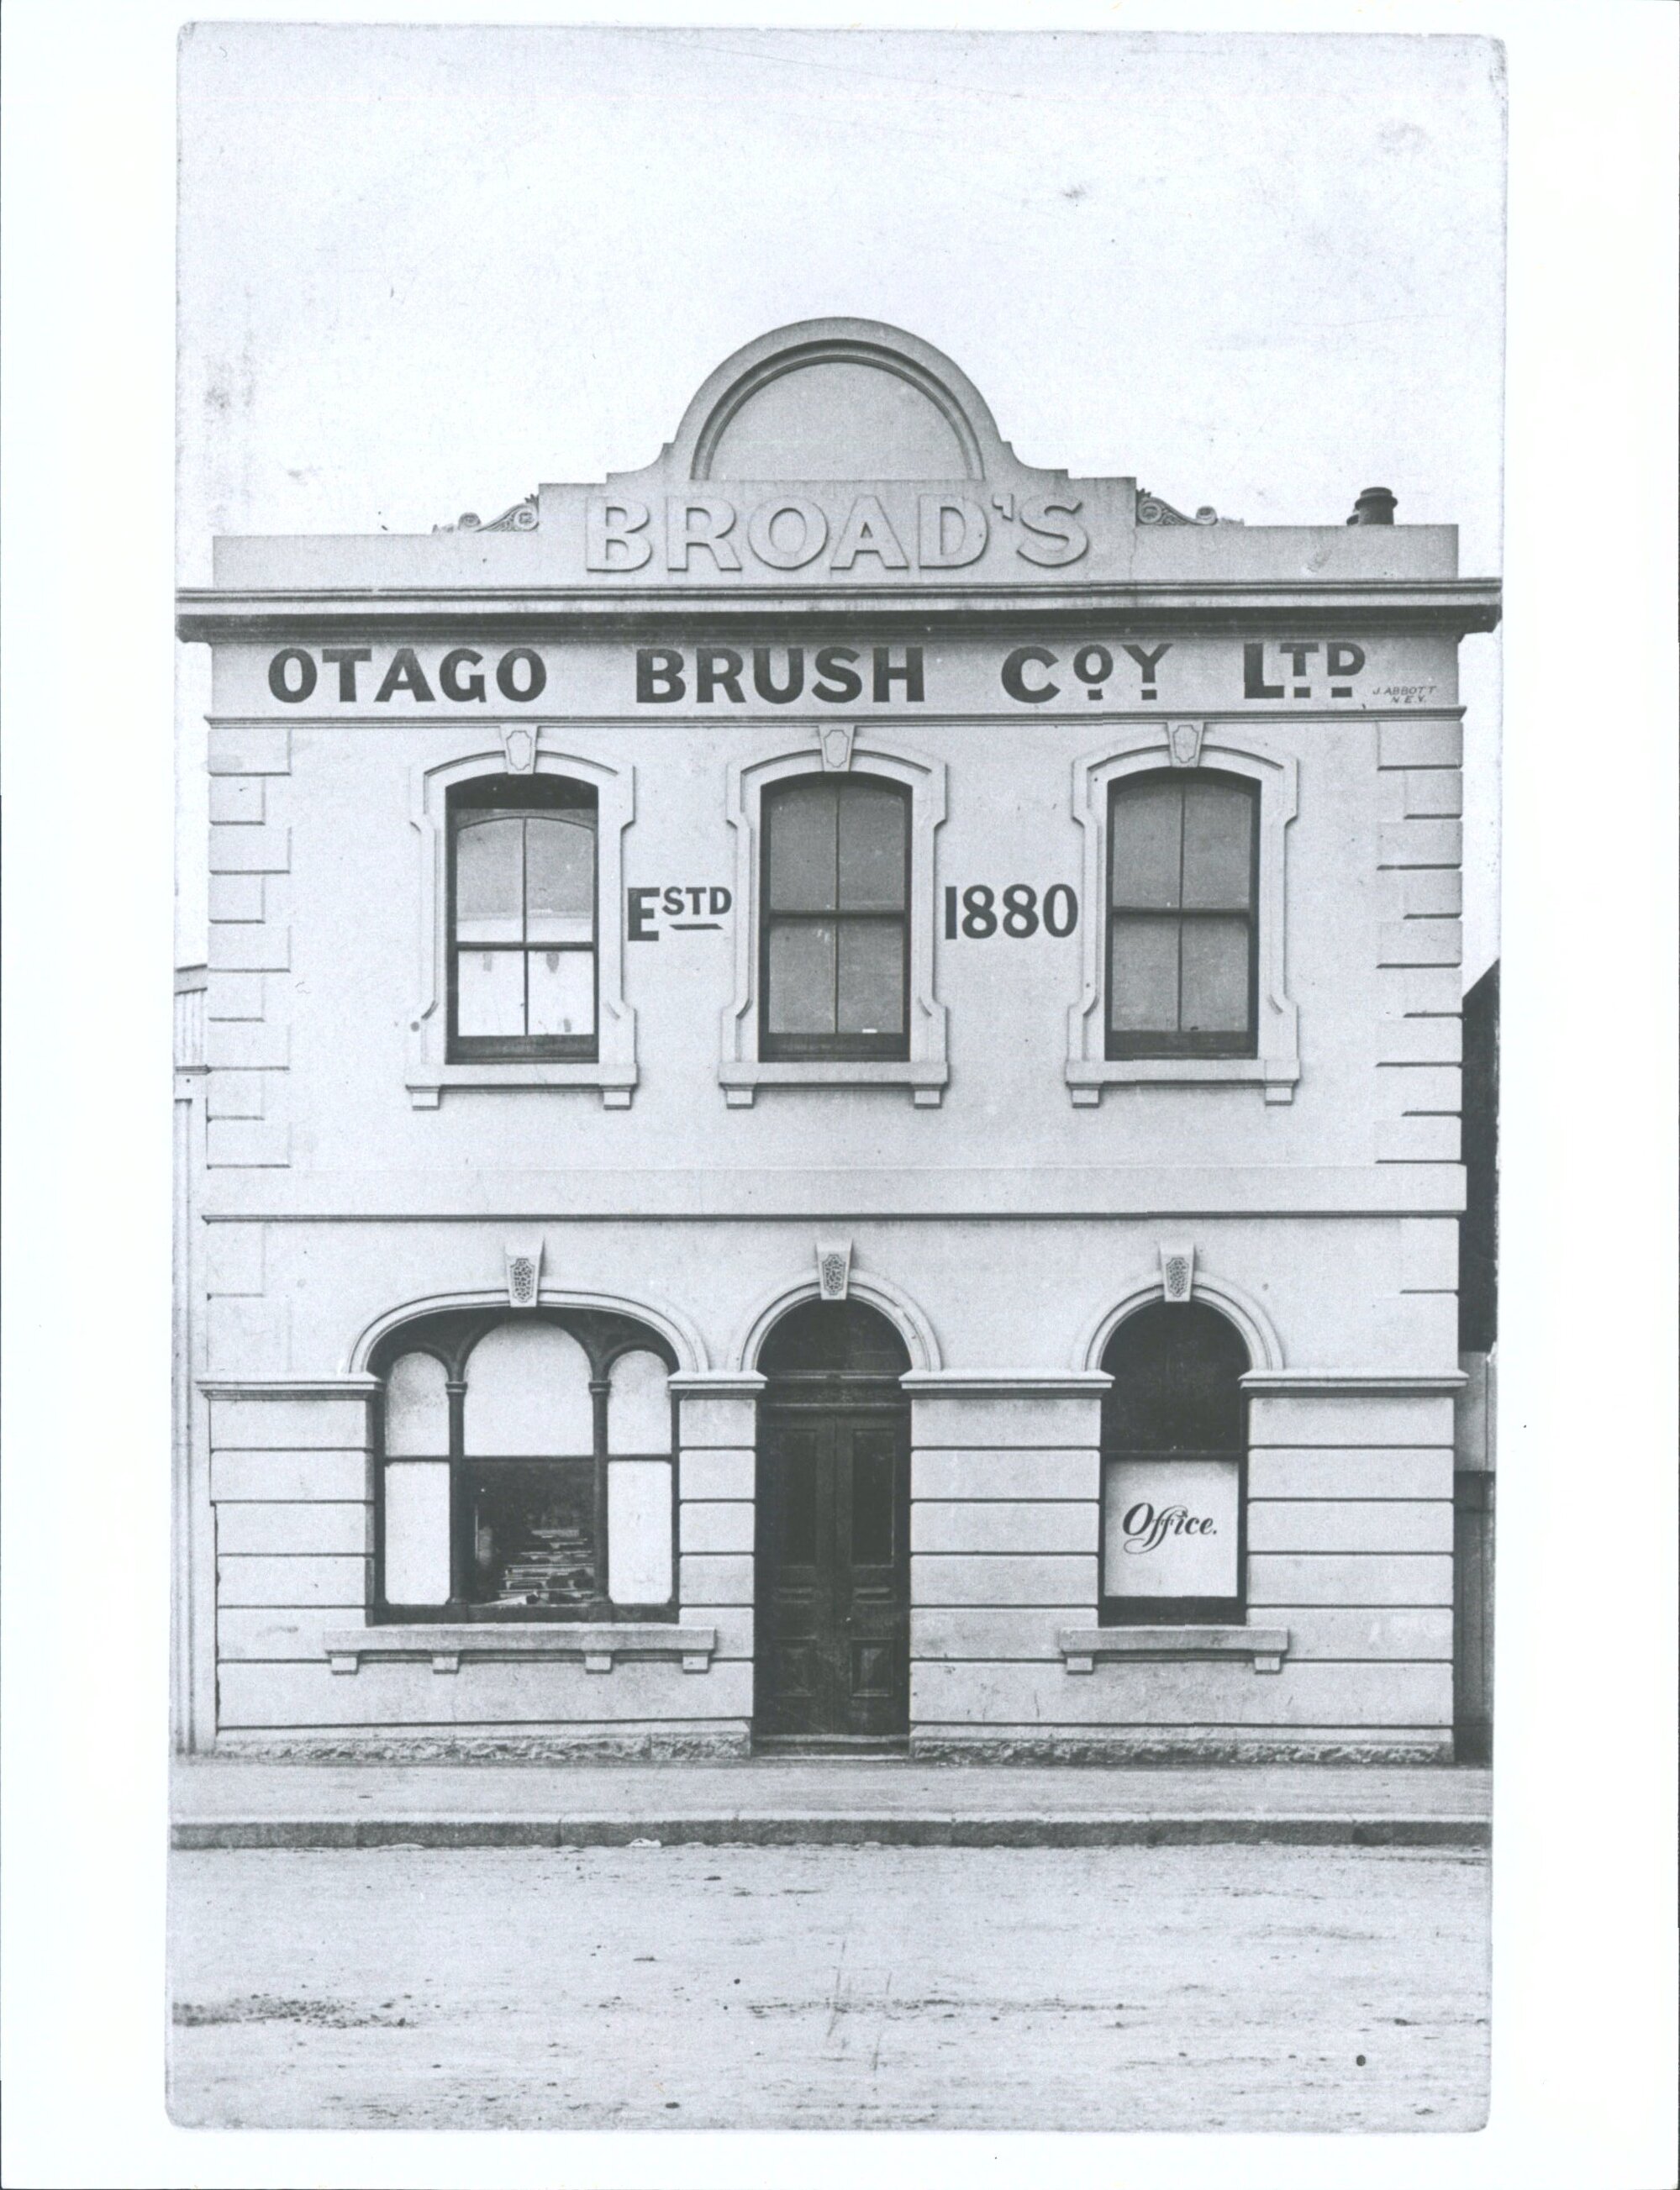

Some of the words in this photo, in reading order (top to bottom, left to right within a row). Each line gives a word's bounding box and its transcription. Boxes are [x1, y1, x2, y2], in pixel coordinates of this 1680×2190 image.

[587, 492, 1089, 573] BROAD'S
[267, 648, 547, 703] OTAGO
[635, 646, 925, 704] BRUSH
[1243, 641, 1367, 699] LTD
[1383, 685, 1437, 696] ABBOTT
[627, 886, 732, 941] ESTD
[944, 883, 1078, 940] 1880
